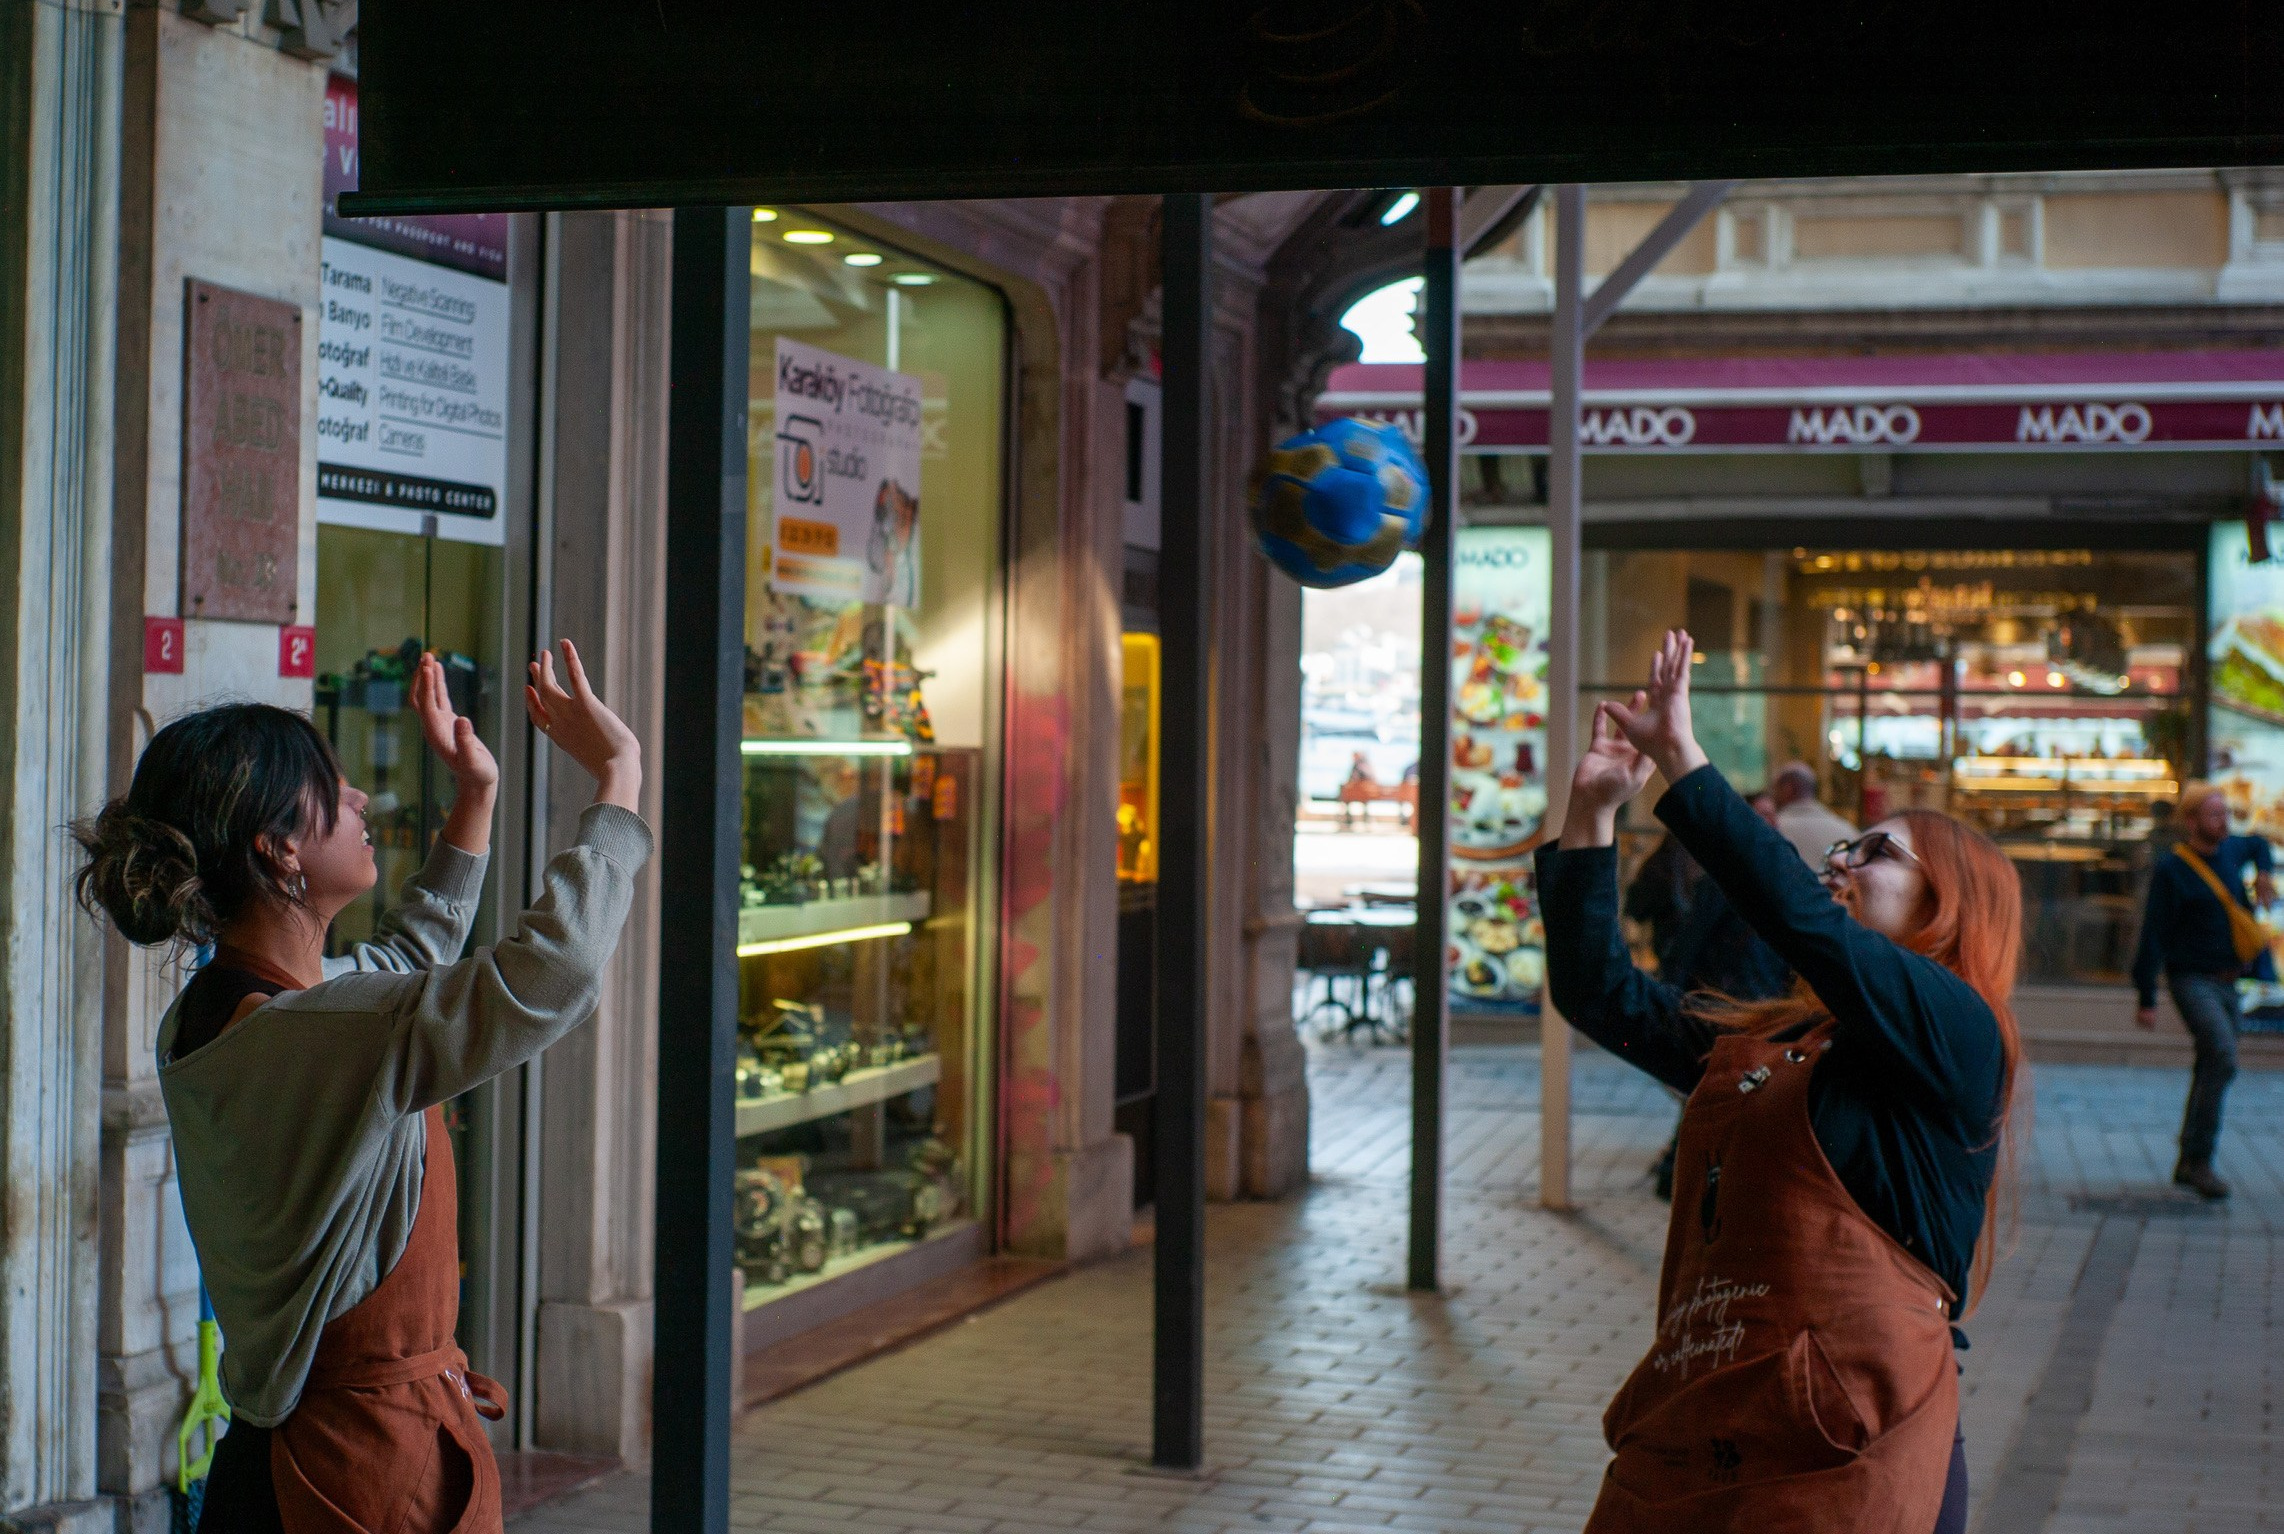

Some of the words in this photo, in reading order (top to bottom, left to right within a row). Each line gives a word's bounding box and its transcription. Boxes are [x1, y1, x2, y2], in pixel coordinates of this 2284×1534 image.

[321, 260, 372, 294] Tarama
[328, 300, 371, 331] Banyo
[779, 352, 843, 415] Karaköy
[1787, 404, 1921, 444] MADO
[2016, 402, 2153, 444] MADO
[399, 483, 441, 504] PHOTO
[446, 490, 492, 510] CENTER
[161, 629, 173, 661] 2
